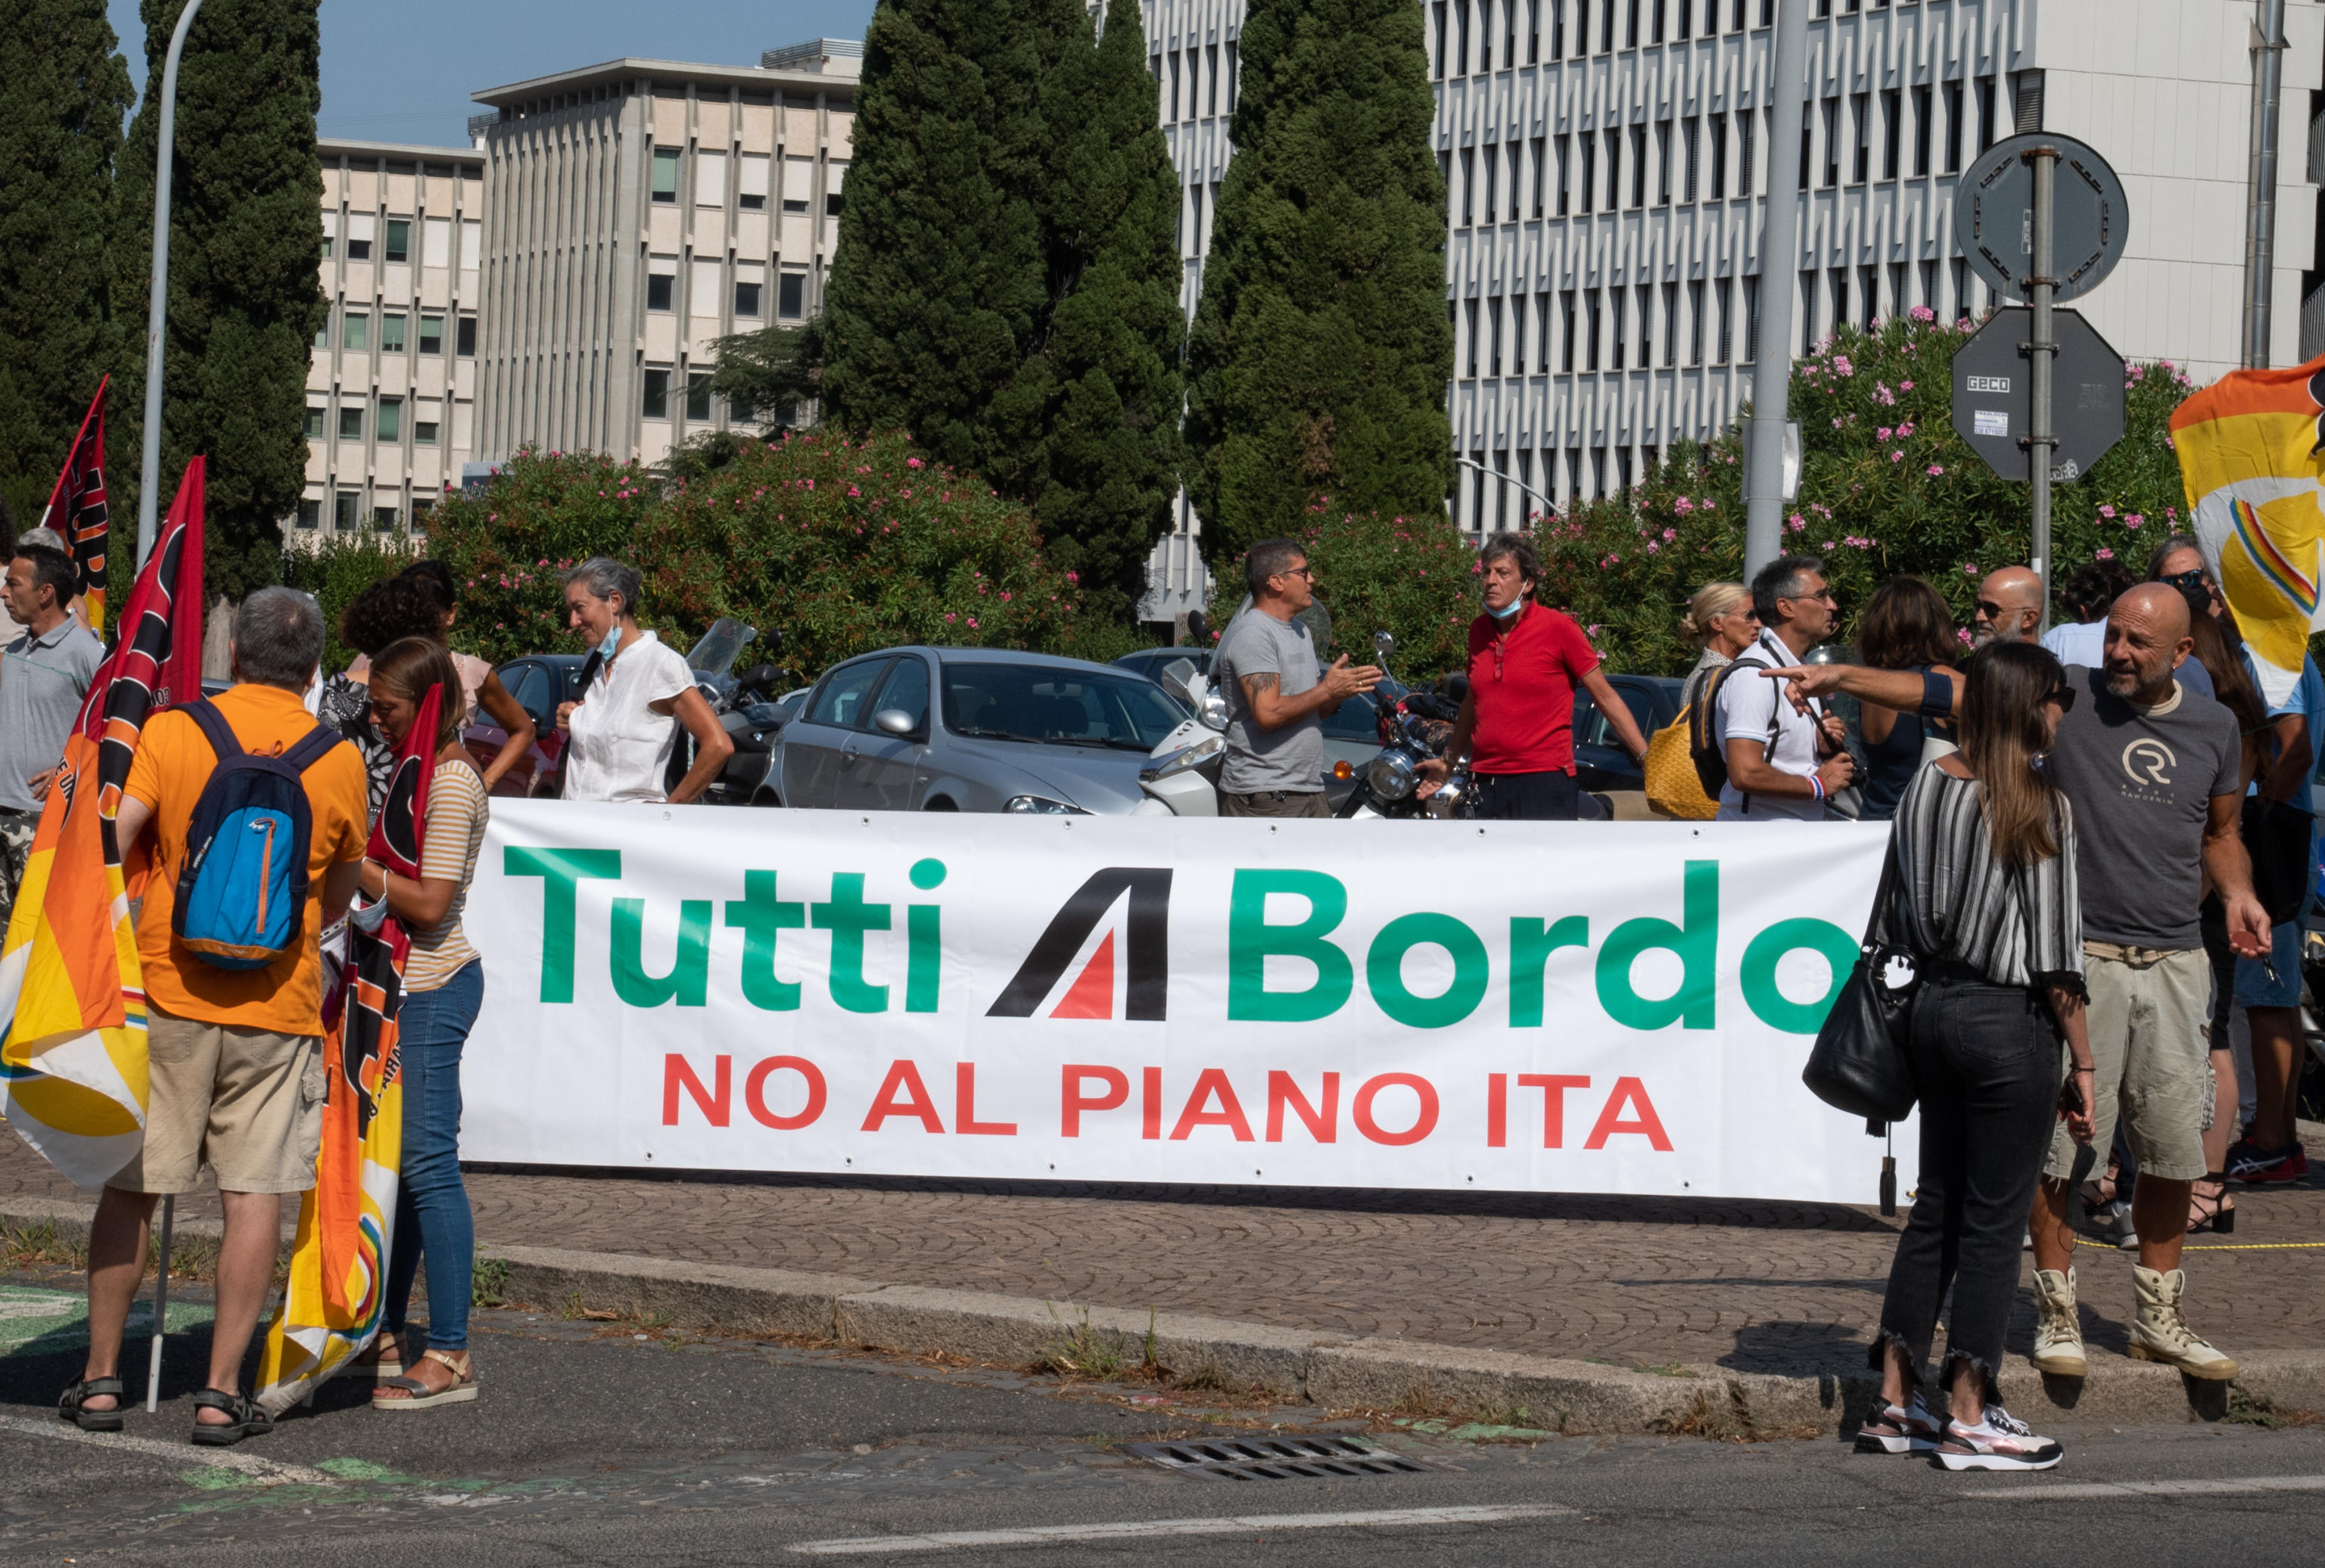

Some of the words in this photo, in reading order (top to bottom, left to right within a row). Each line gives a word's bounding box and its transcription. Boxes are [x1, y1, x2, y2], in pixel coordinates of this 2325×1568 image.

[504, 846, 947, 1013] Tutti
[986, 868, 1172, 1020] A
[1228, 860, 1860, 1034] Bordo
[663, 1053, 826, 1130] NO
[861, 1060, 1017, 1135] AL
[1062, 1064, 1439, 1146] PIANO
[1488, 1074, 1673, 1151] ITA
